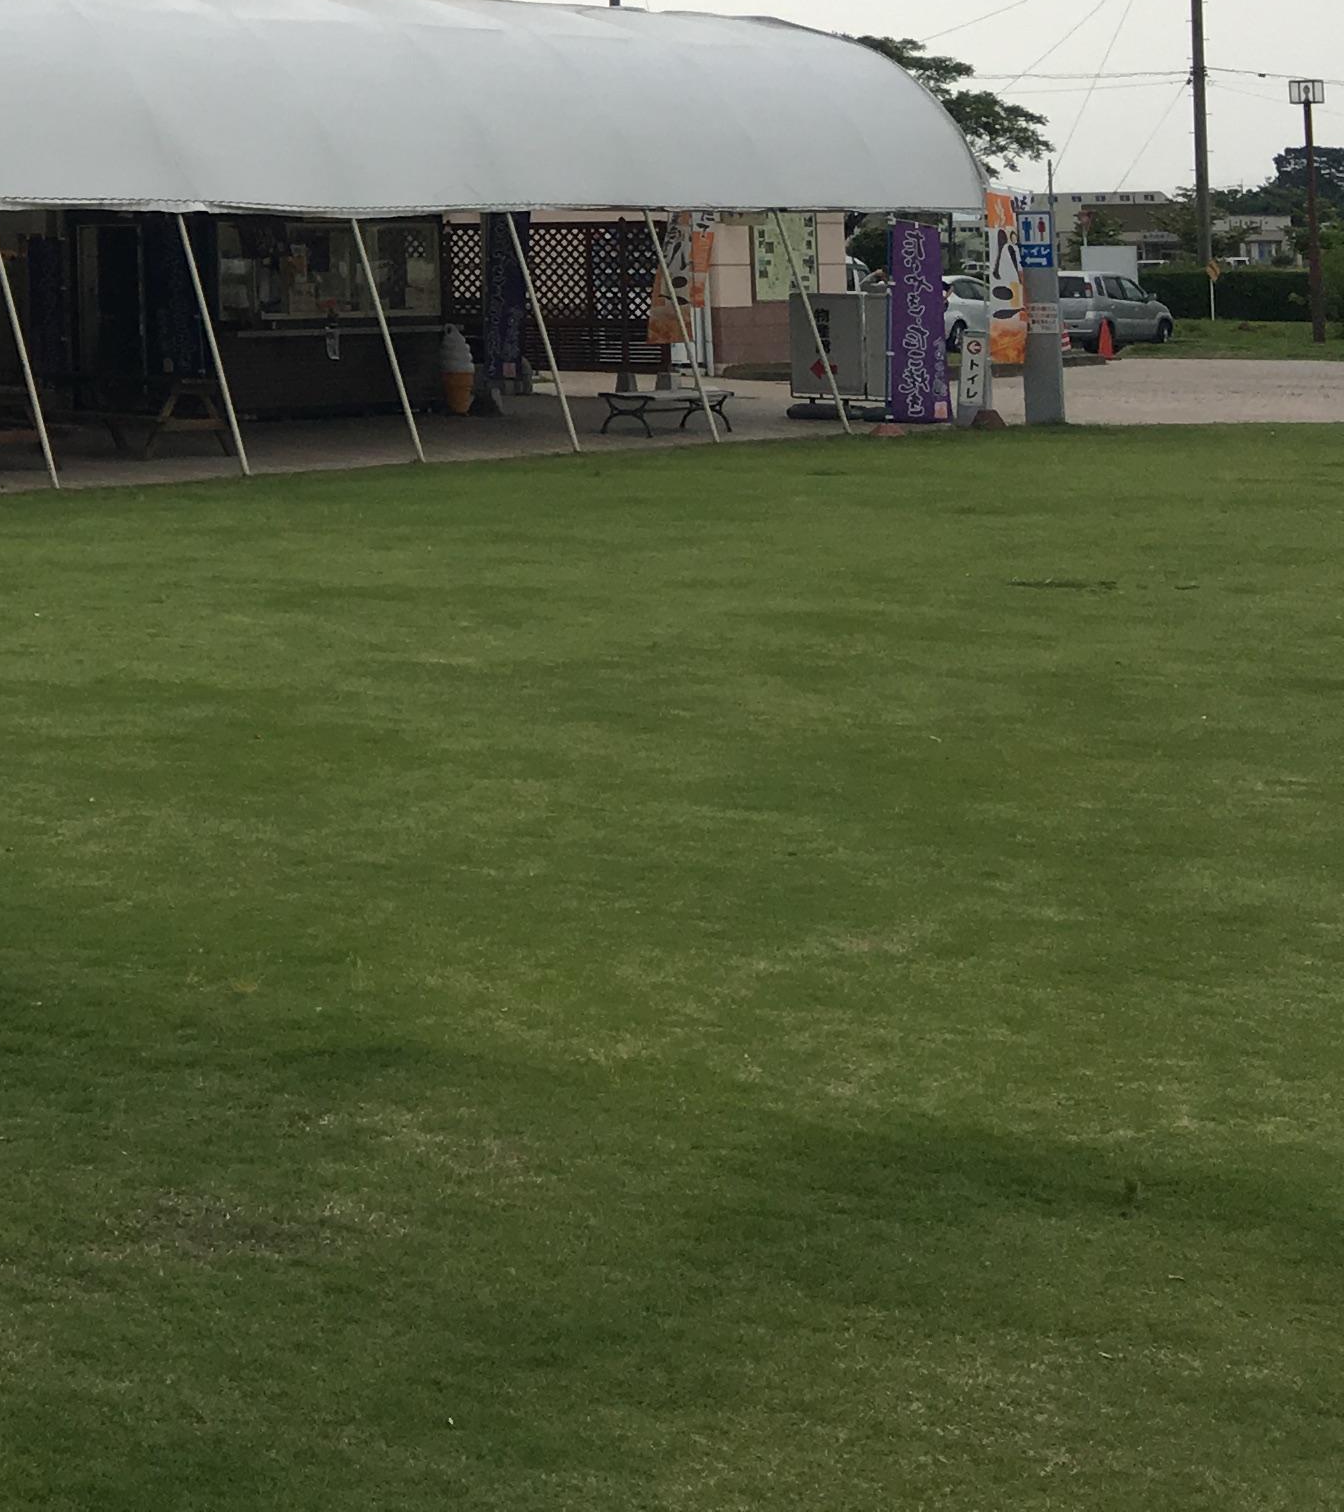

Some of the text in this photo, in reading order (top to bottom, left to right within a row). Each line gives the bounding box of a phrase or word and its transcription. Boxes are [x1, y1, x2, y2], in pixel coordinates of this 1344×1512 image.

[1020, 246, 1050, 256] トイレ
[966, 359, 980, 399] トイレ
